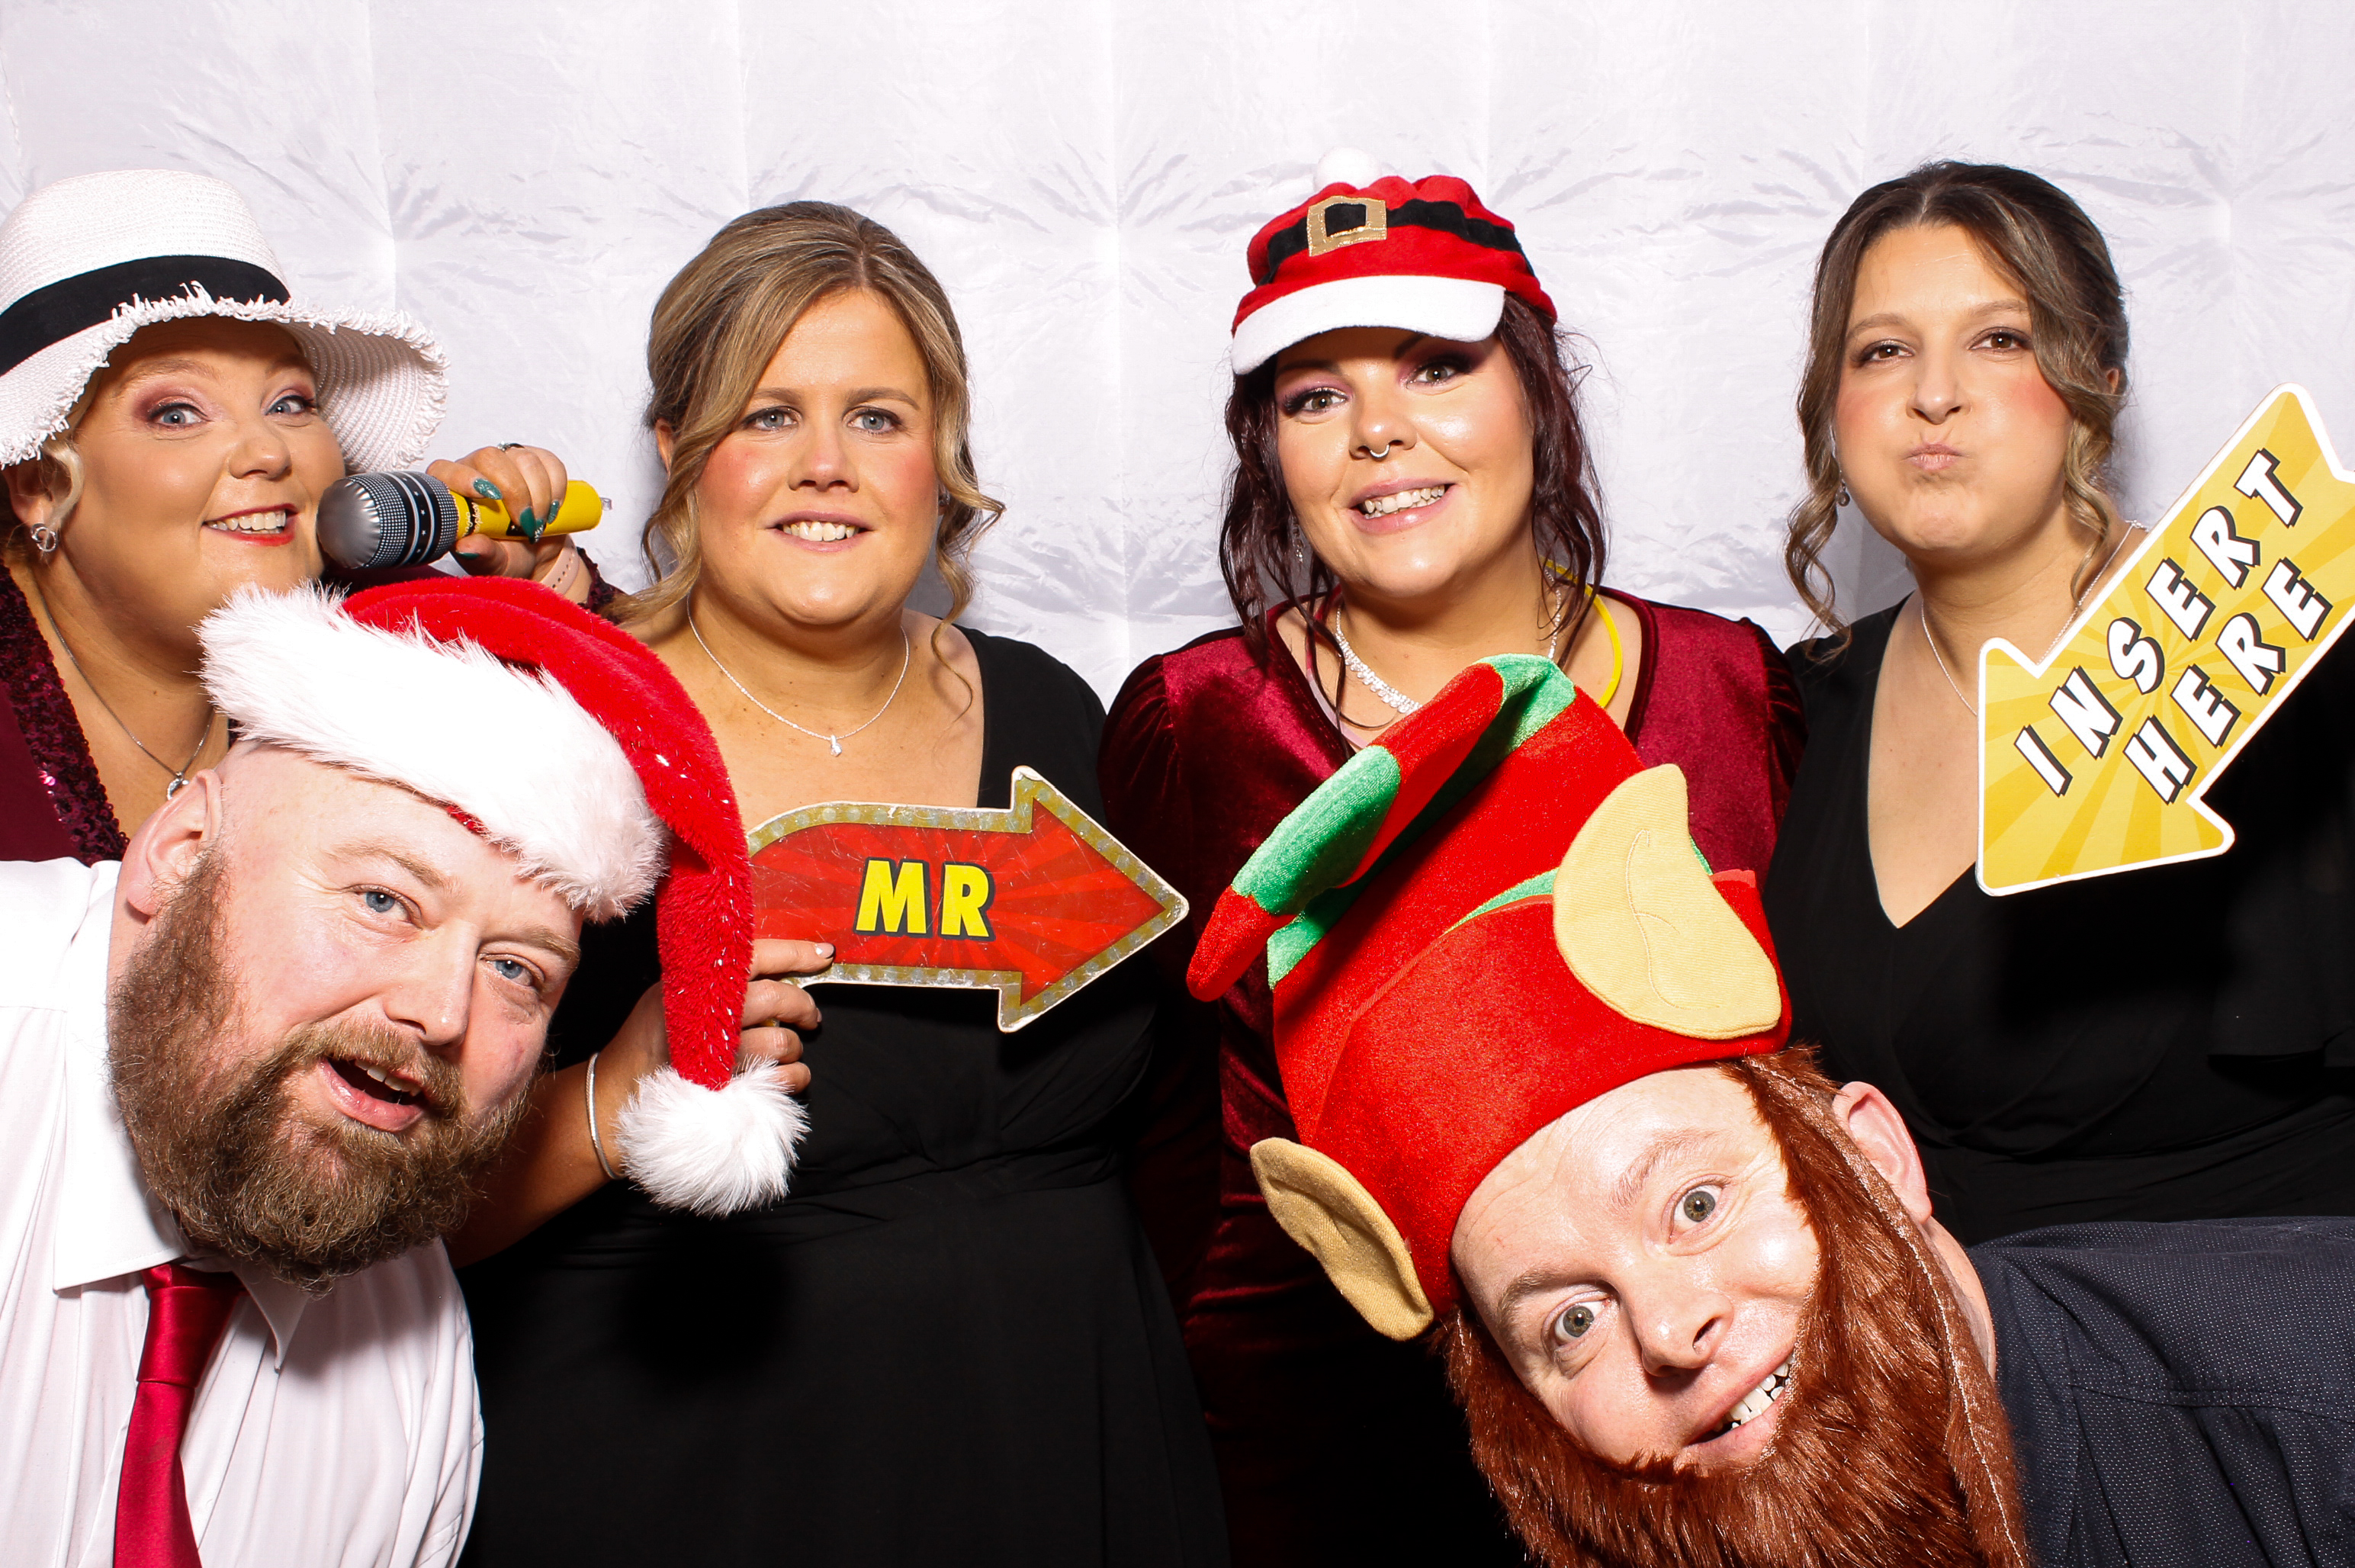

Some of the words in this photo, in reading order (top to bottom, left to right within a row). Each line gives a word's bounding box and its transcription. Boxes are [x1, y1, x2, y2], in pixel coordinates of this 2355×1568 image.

[2013, 448, 2303, 797] INSERT
[2122, 557, 2334, 805] HERE
[854, 857, 995, 940] MR
